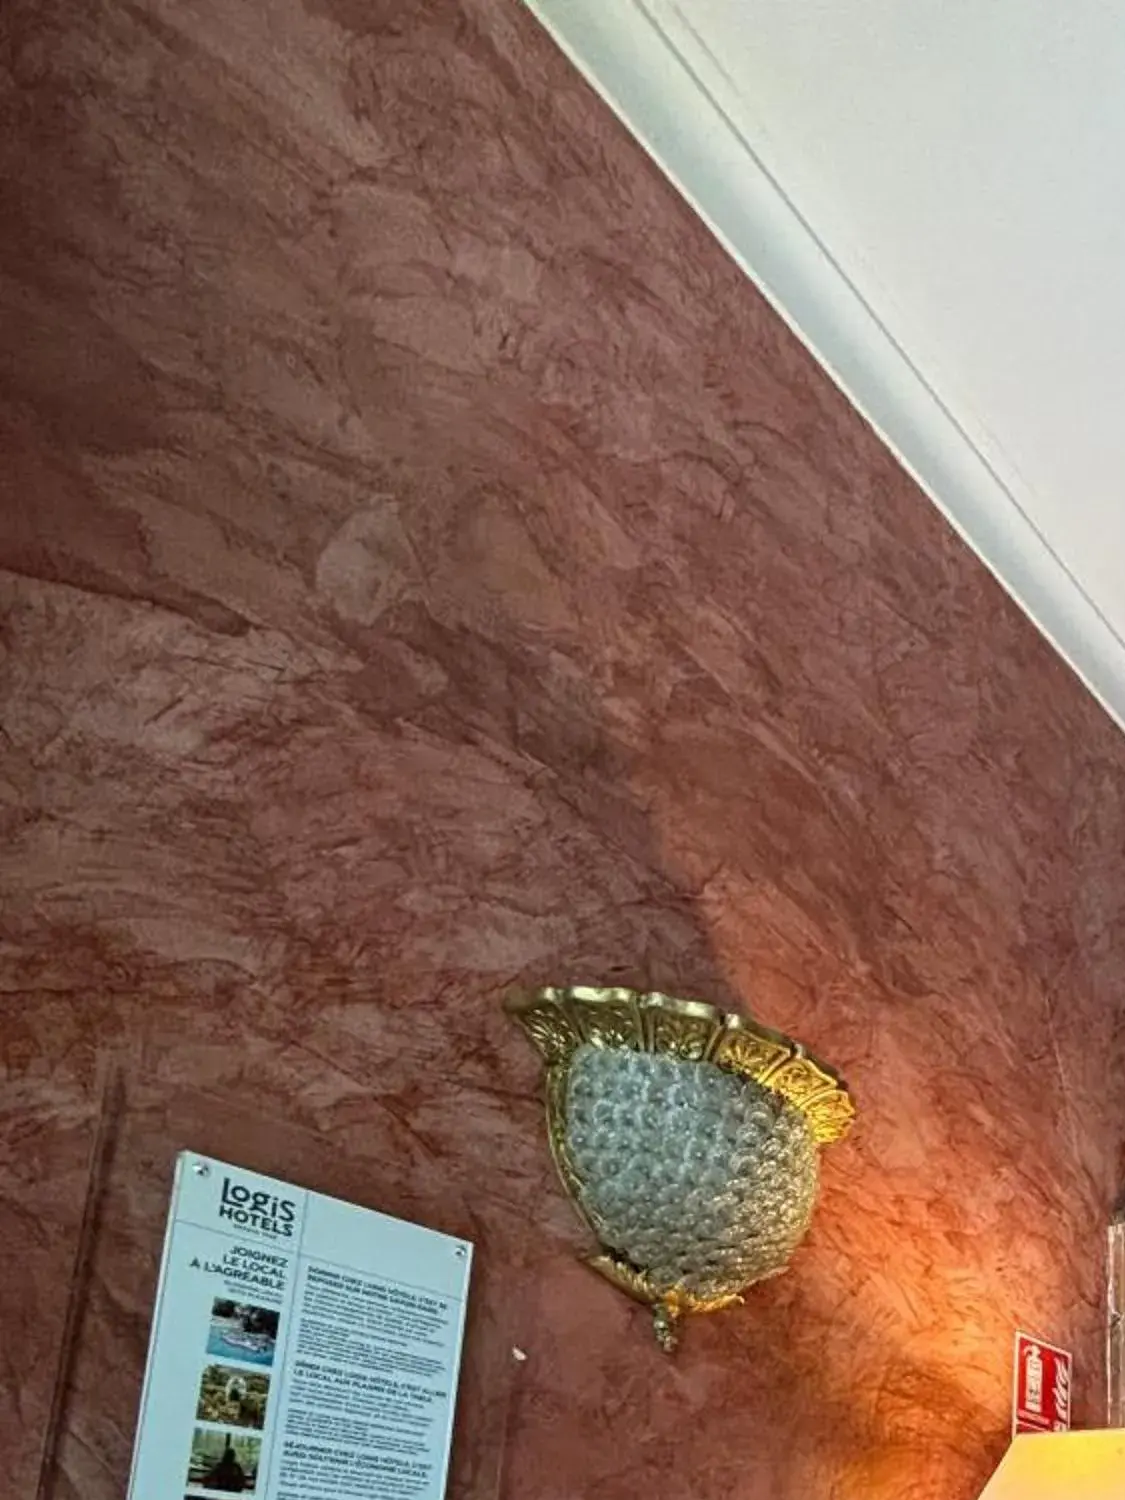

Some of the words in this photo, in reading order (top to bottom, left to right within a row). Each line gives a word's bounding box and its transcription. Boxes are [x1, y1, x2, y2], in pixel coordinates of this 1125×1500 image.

[219, 1205, 294, 1237] HOTELS
[222, 1254, 239, 1266] LE
[242, 1259, 286, 1279] LOCAL
[229, 1246, 288, 1268] JOIGNEZ
